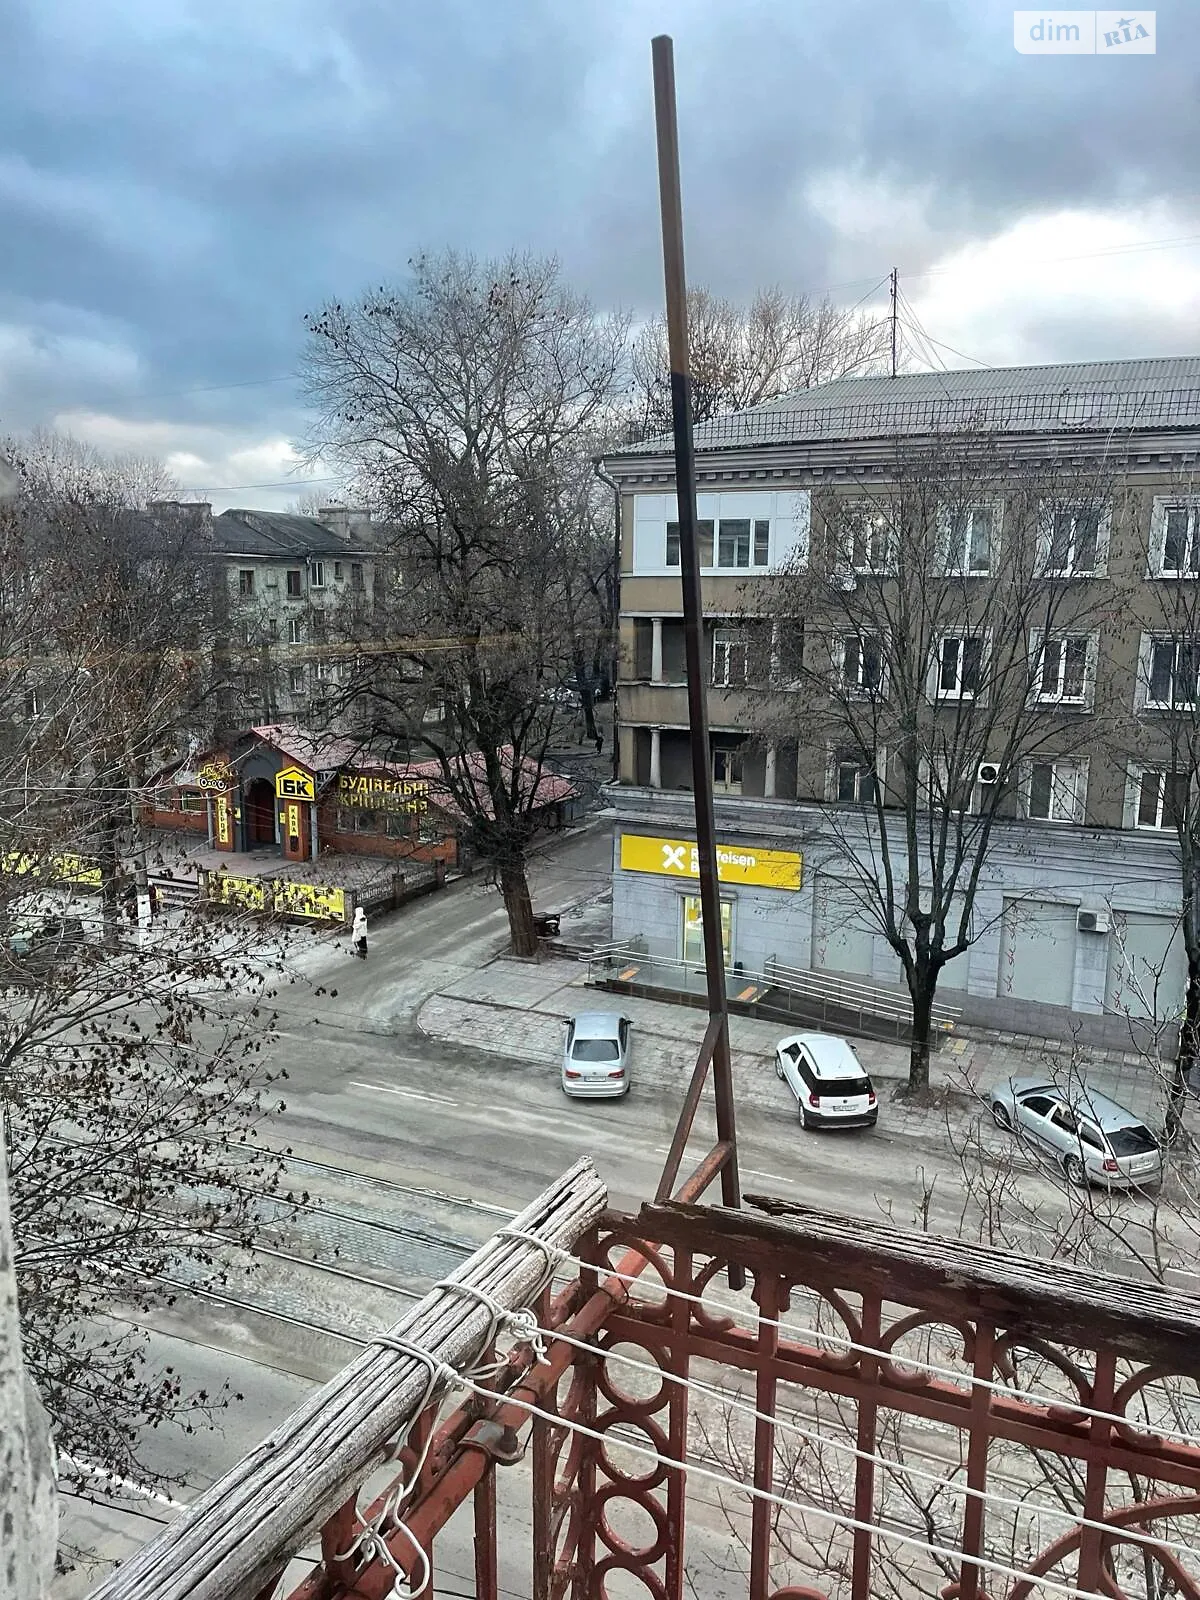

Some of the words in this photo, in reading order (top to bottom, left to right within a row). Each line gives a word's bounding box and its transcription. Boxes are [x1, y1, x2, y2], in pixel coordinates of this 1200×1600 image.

[283, 779, 310, 796] БК
[290, 807, 298, 833] КАВА
[691, 847, 756, 867] Rfeisen
